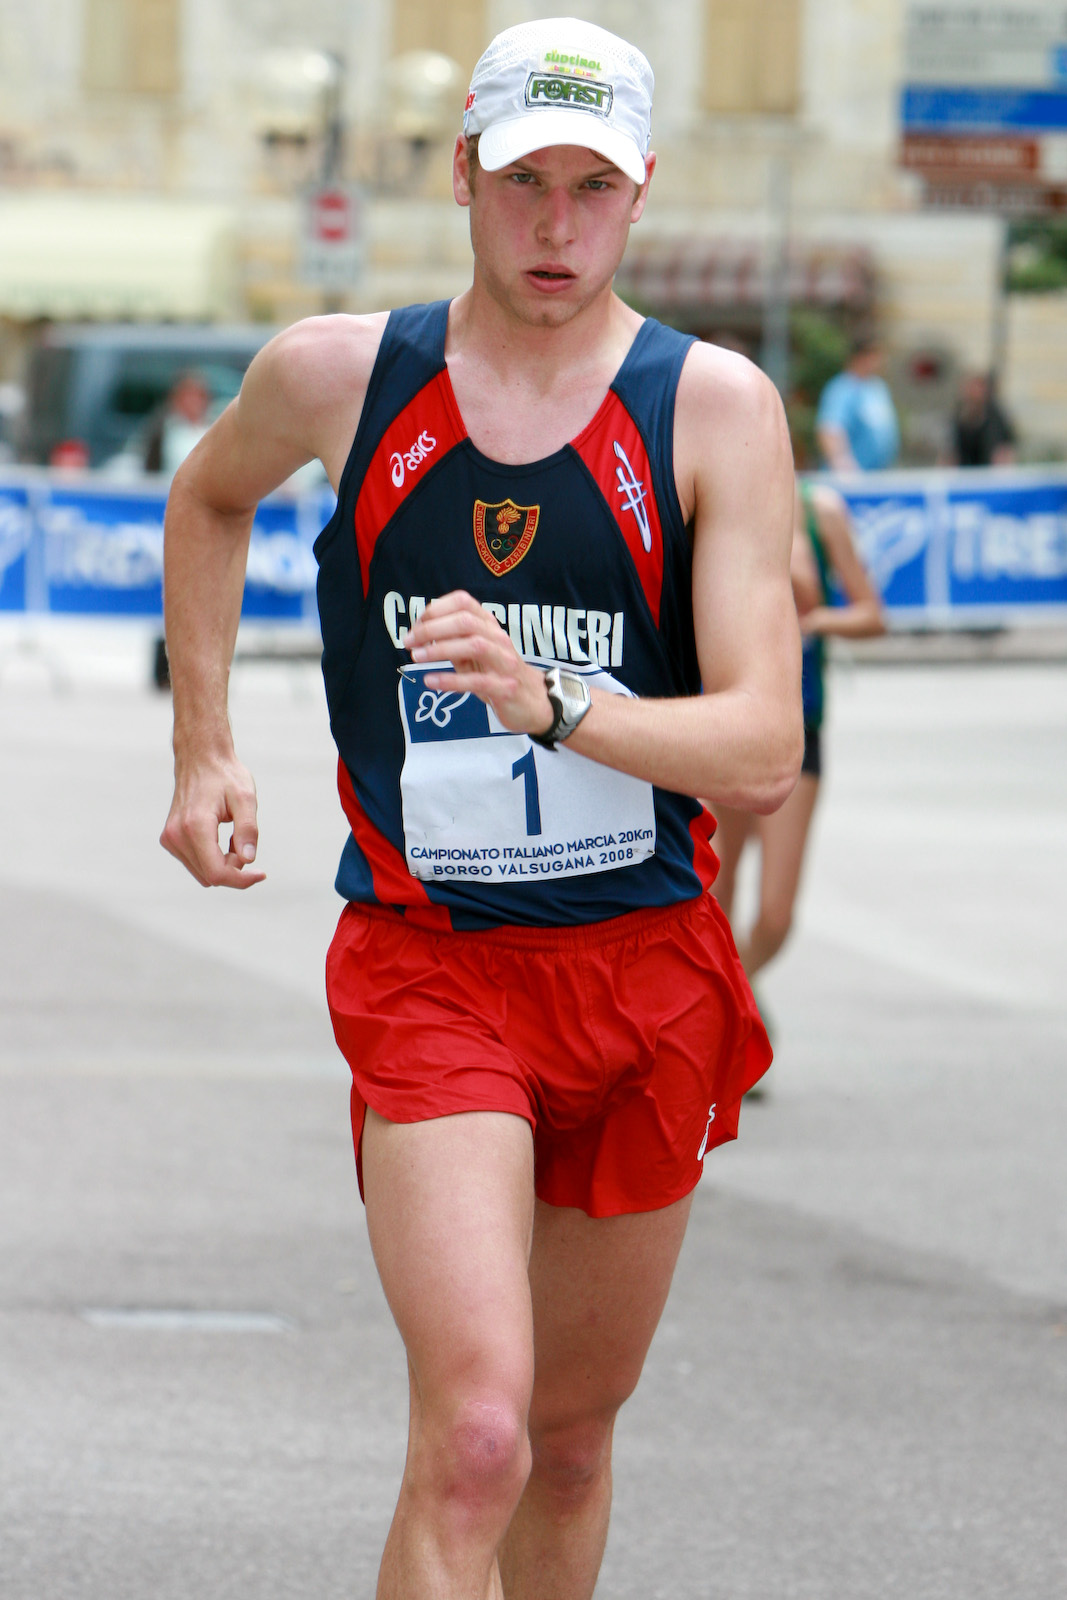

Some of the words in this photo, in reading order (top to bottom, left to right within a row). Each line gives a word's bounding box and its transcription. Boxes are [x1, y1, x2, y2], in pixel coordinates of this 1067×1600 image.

[531, 79, 609, 107] FORST
[476, 505, 484, 538] CENTRO
[477, 537, 501, 571] SPORTIVO
[504, 515, 536, 568] CARABINIERI
[512, 745, 542, 836] 1
[410, 847, 499, 861] CAMPIONATO
[503, 843, 565, 860] ITALIANO
[567, 834, 617, 853] MARCIA
[618, 828, 653, 844] 20Km
[433, 865, 493, 876] BORGO
[498, 855, 595, 875] VALSUGANA
[599, 847, 634, 865] 2008
